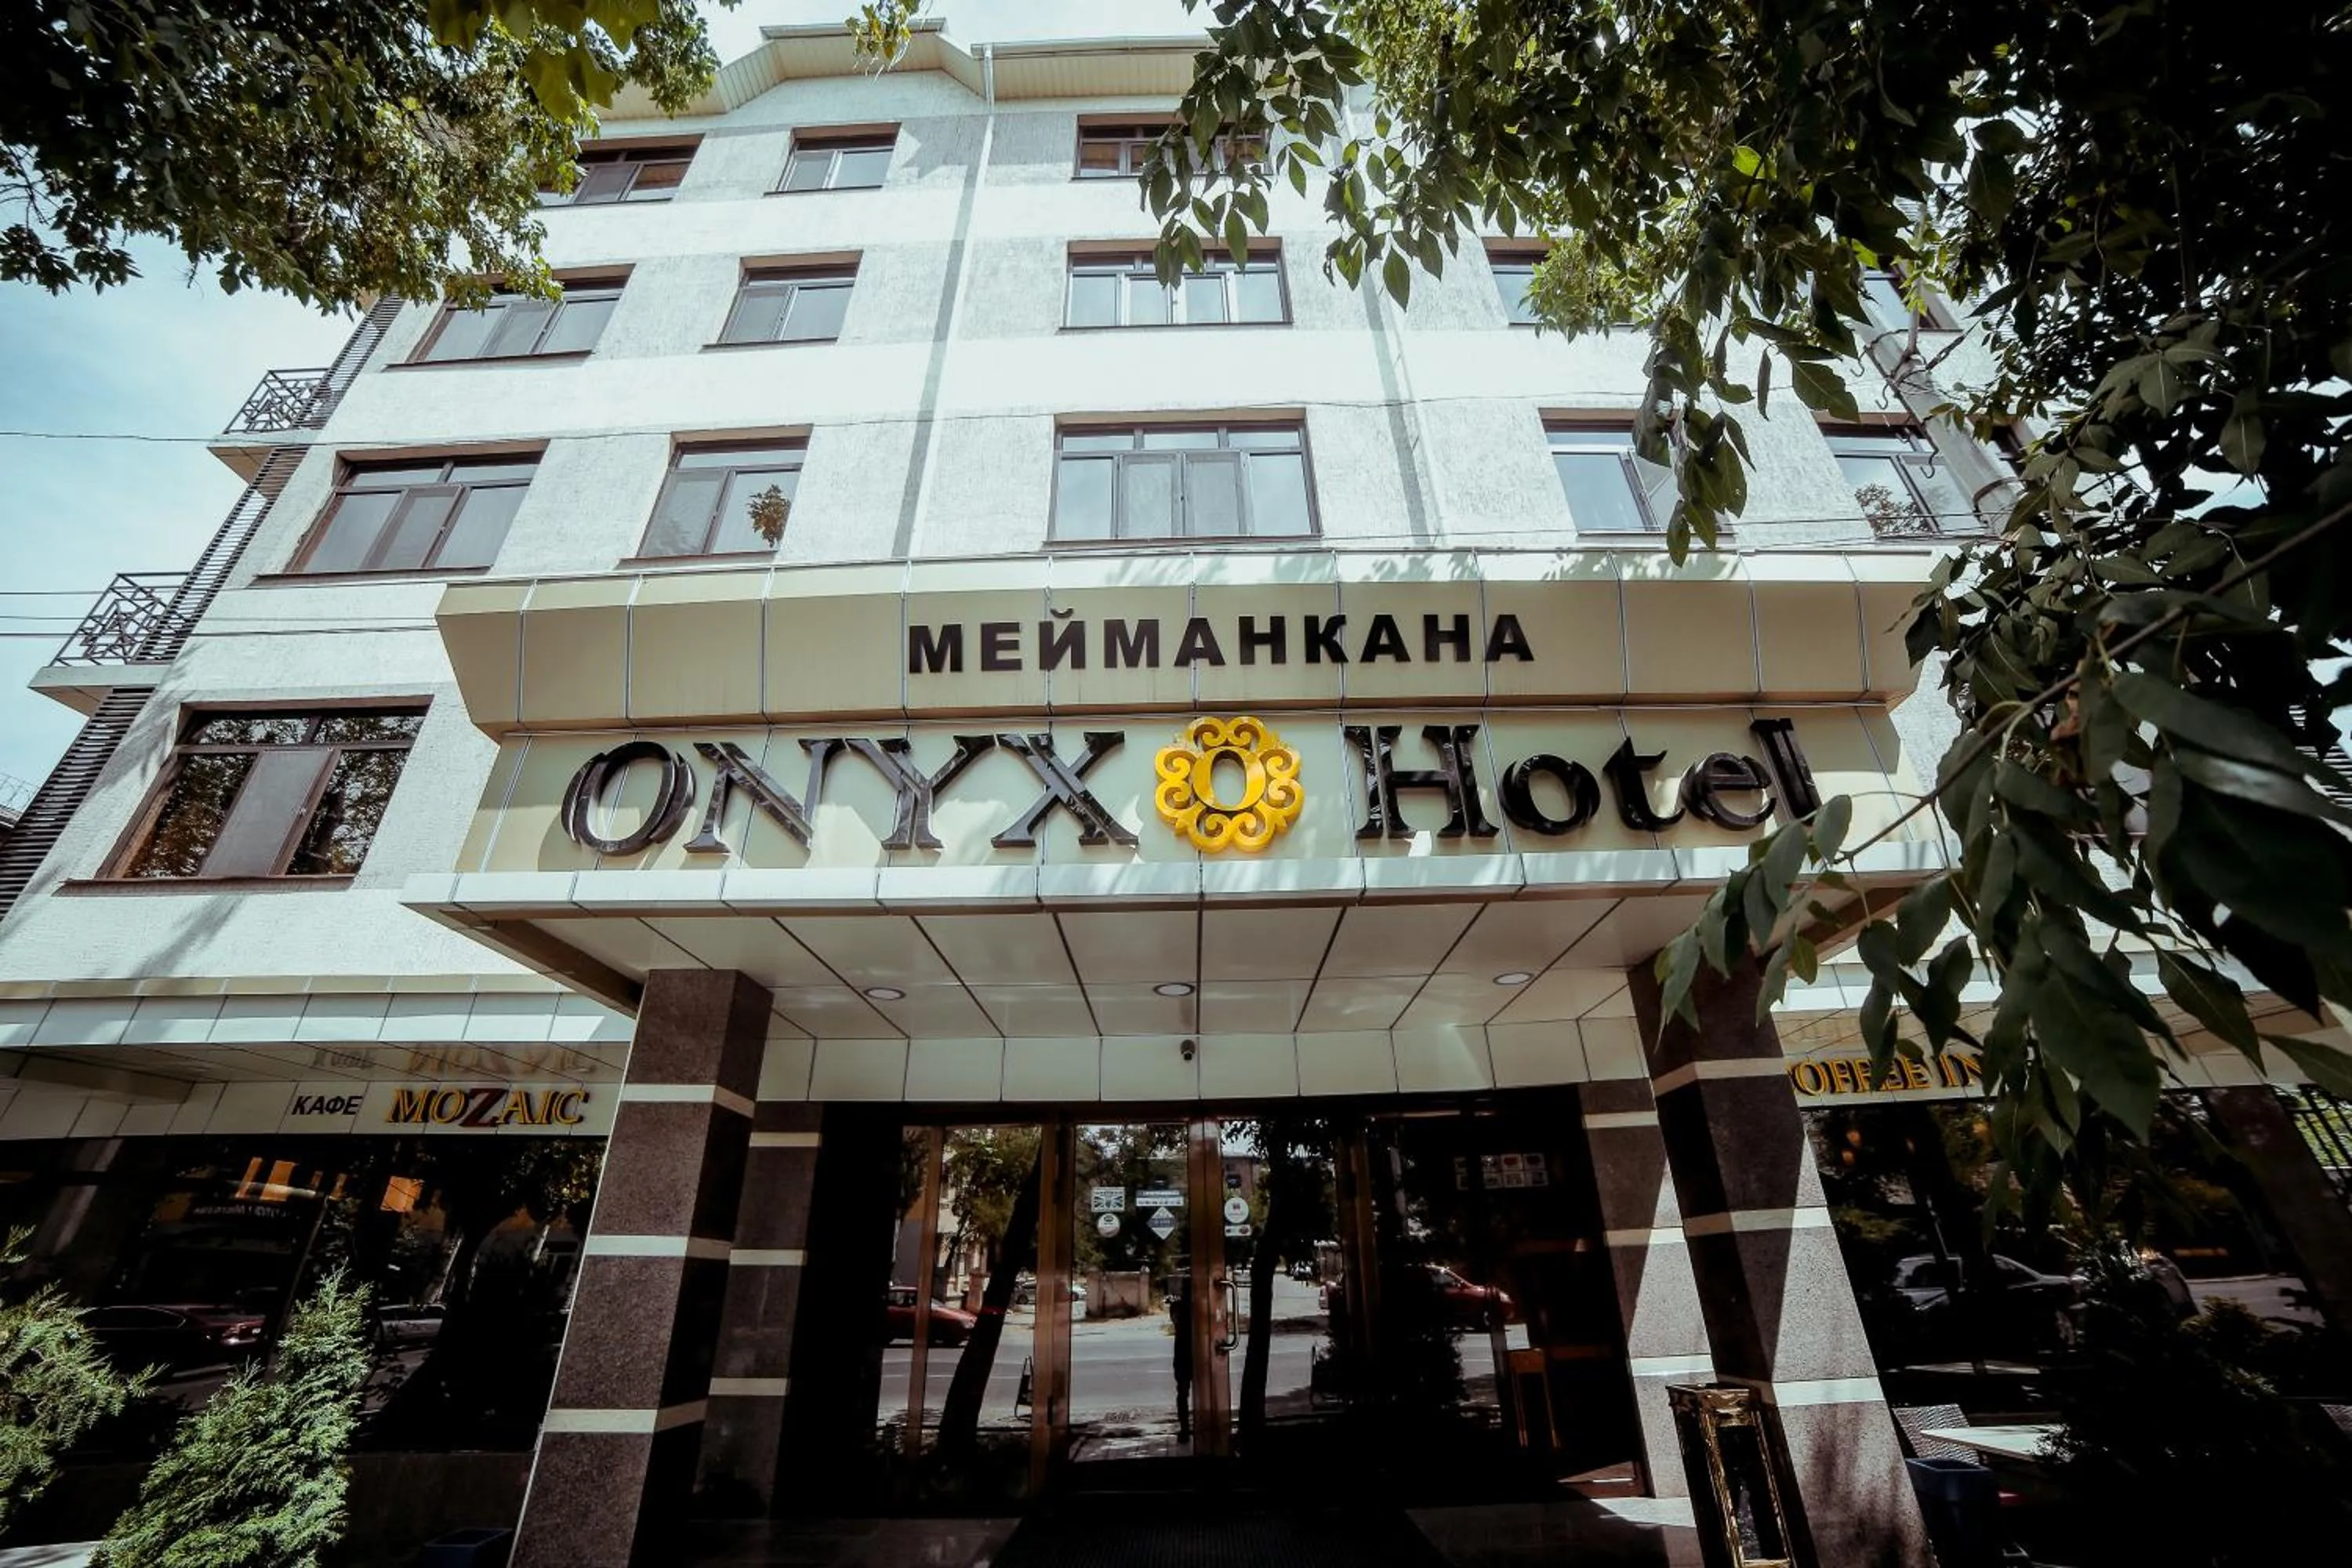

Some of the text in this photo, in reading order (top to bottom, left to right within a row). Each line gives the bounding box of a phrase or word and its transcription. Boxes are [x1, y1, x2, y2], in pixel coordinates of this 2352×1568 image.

[908, 608, 1535, 674] МЕЙМАНКАНА
[561, 730, 1140, 856] ONYX
[1345, 717, 1823, 840] Hotel
[1788, 1054, 1932, 1097] OFFEE
[291, 1094, 364, 1116] КАФЕ
[387, 1087, 591, 1128] MOZAIC
